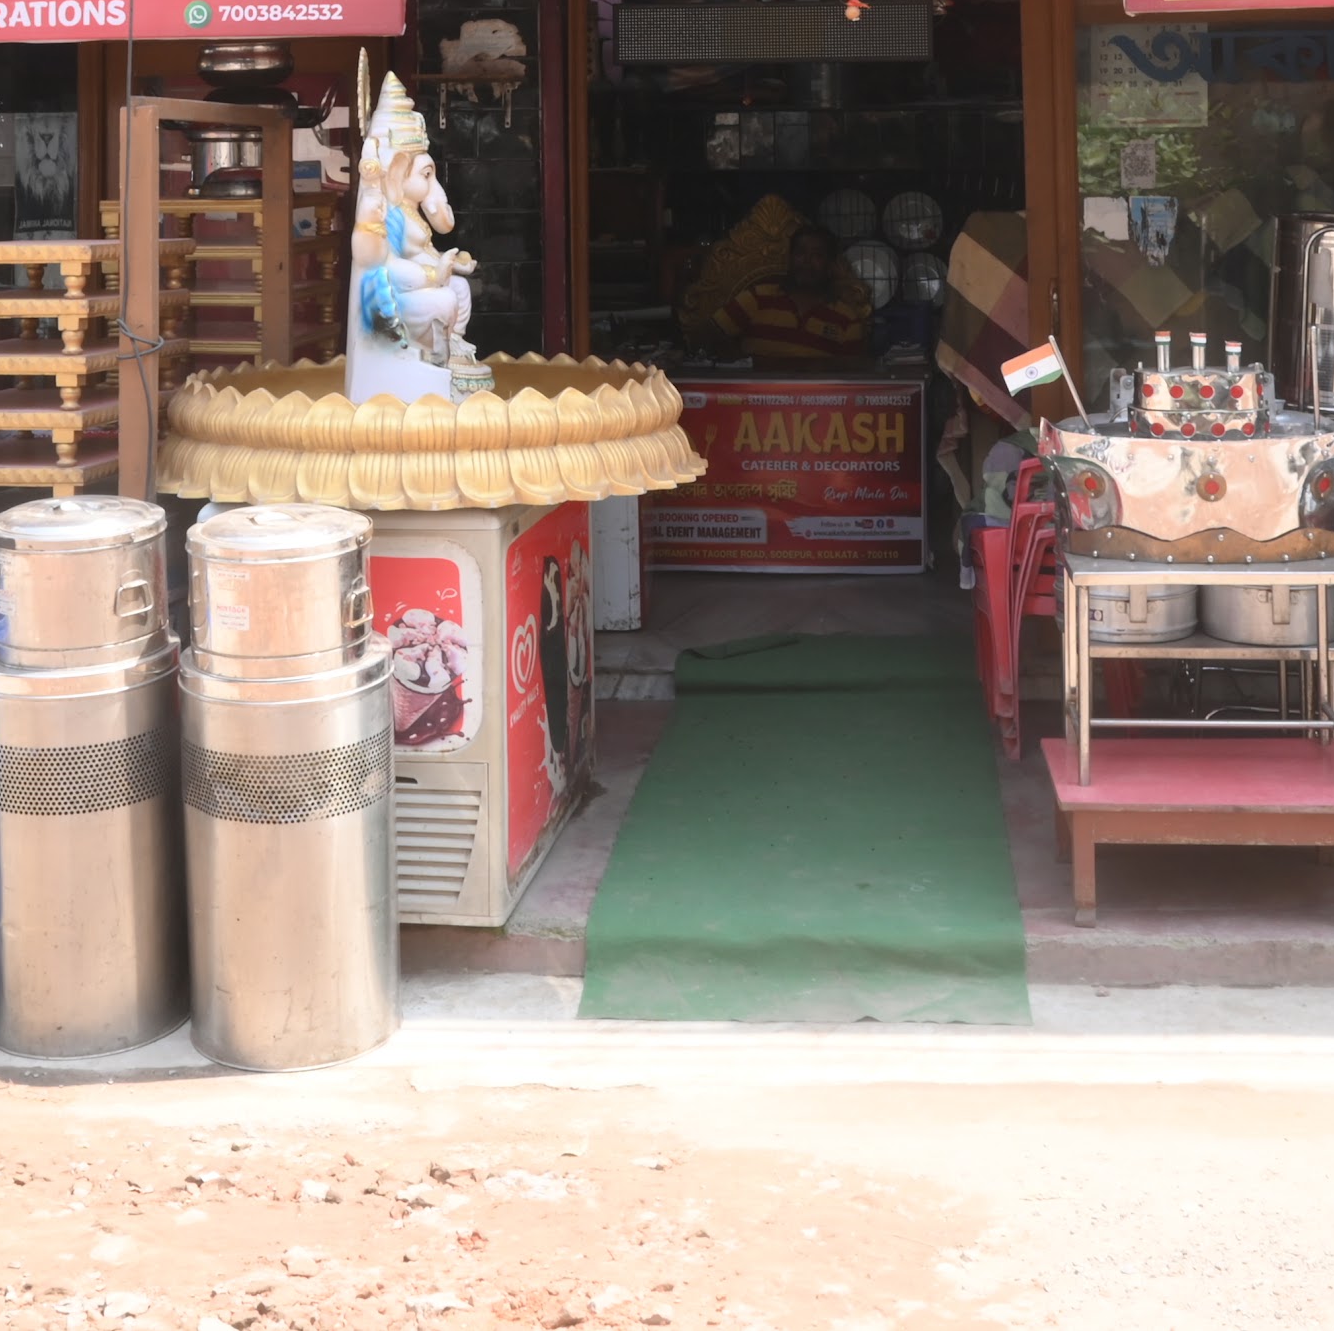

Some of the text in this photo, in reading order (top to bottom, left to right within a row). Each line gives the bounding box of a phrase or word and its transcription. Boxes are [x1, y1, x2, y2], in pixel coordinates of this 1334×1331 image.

[219, 3, 343, 22] 7003842532
[734, 411, 905, 454] AAKASH
[741, 459, 901, 472] CATERER & DECORATORS
[659, 513, 739, 523] BOOKING OPENED
[667, 527, 762, 539] EVENT MANAGEMENT
[702, 549, 739, 560] TAGORE
[817, 550, 859, 560] KOLKATA
